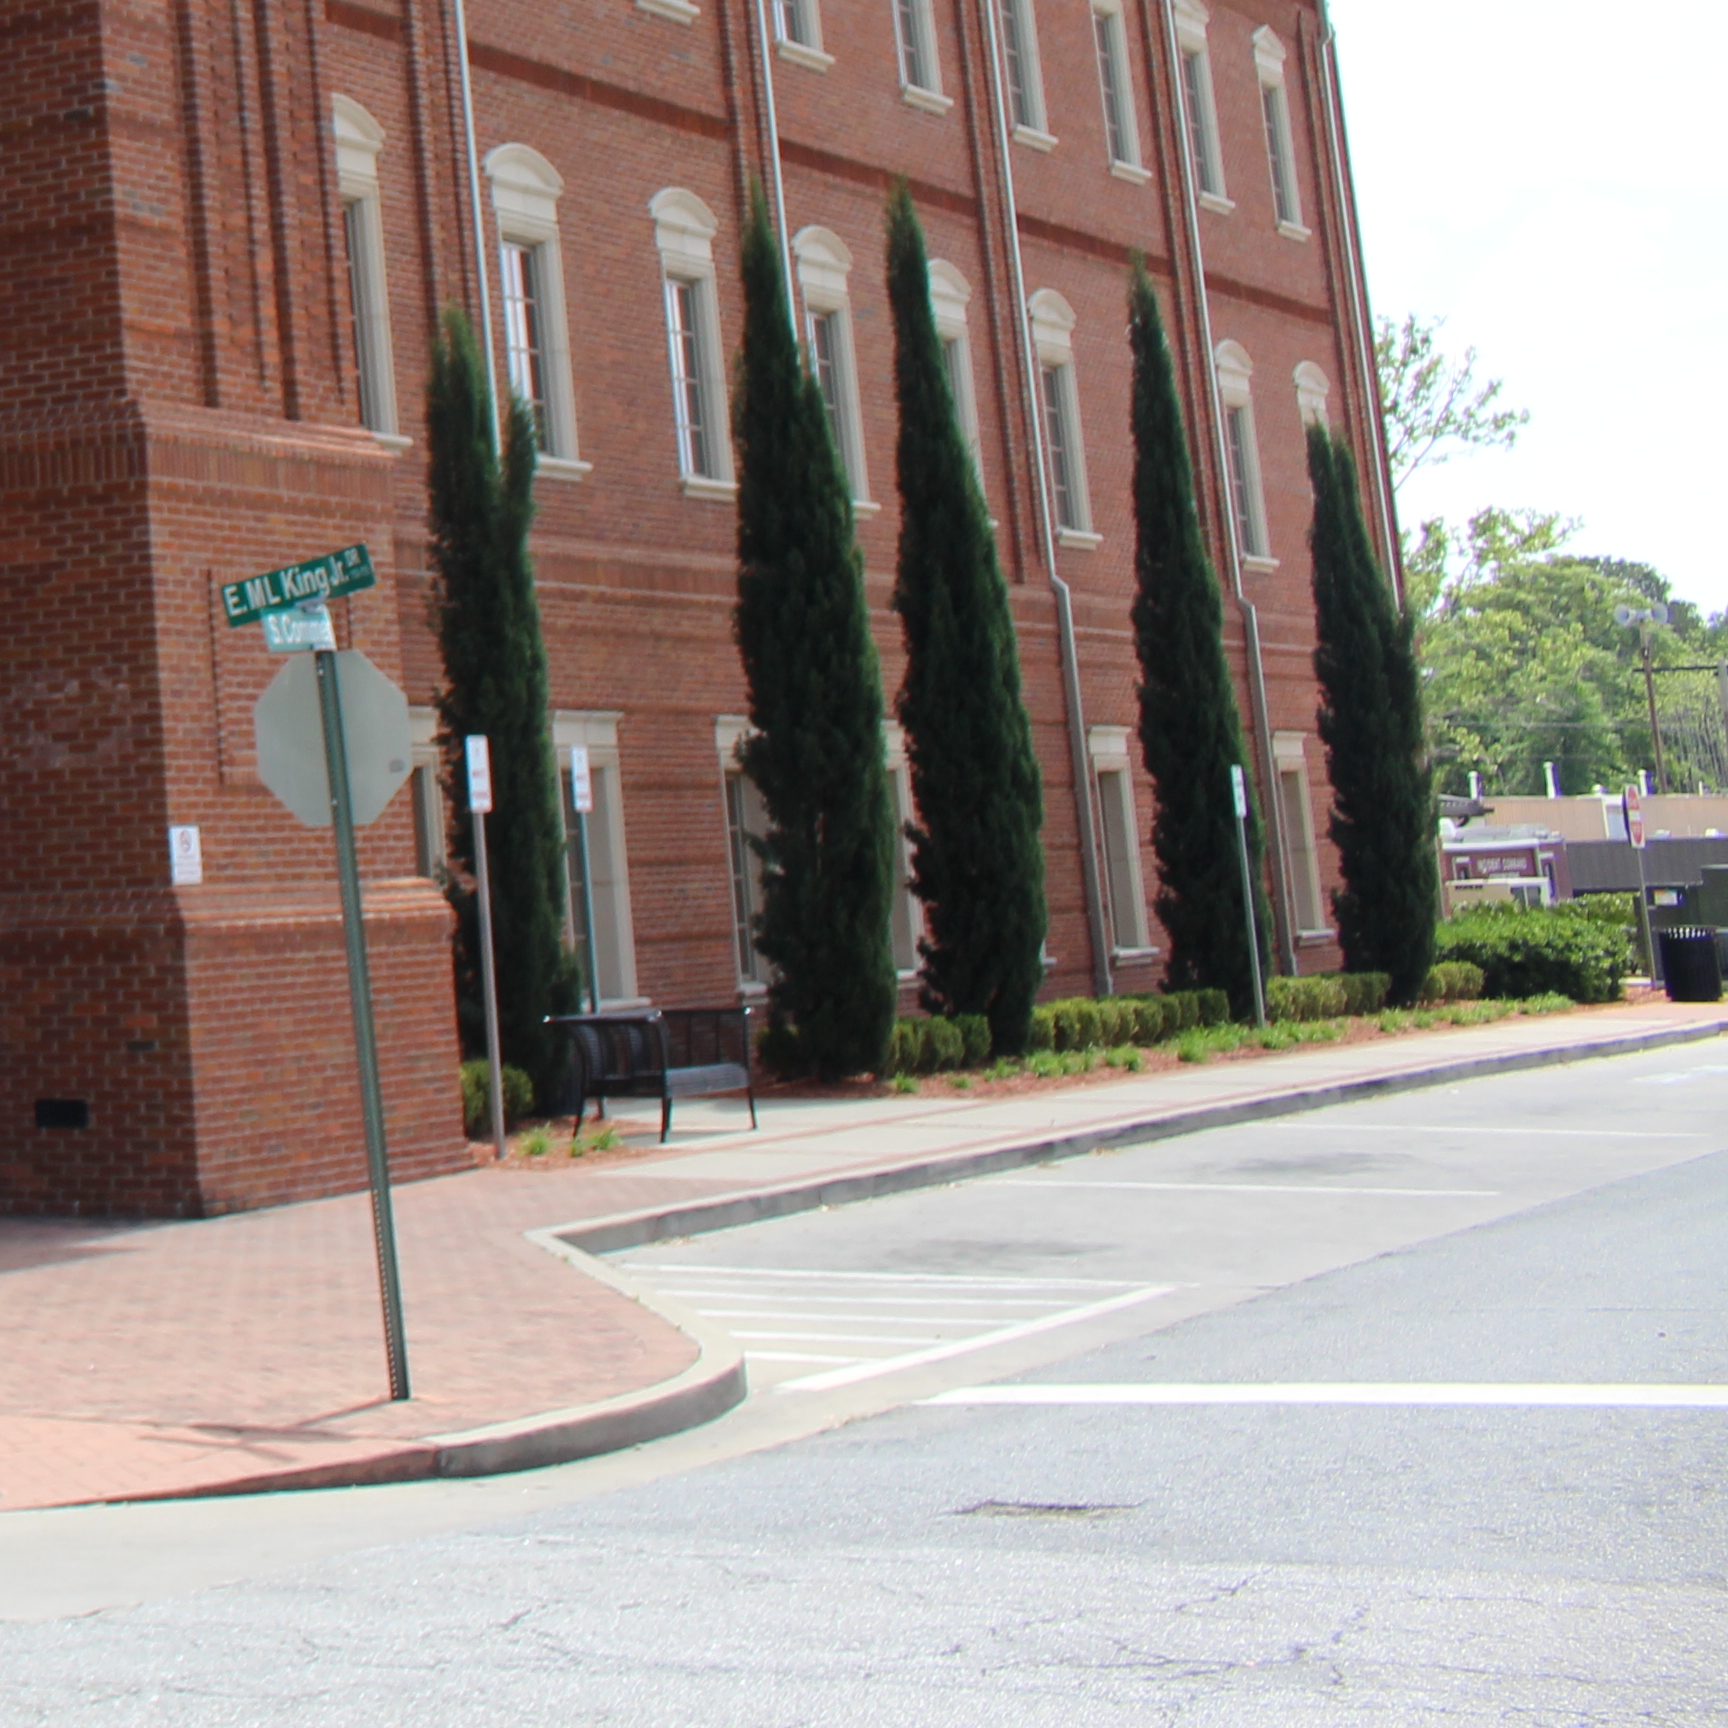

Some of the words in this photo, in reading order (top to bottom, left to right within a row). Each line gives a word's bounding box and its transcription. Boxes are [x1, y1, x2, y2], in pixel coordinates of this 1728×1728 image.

[245, 576, 281, 610] ML
[279, 566, 331, 599] King
[328, 555, 350, 587] Jr.
